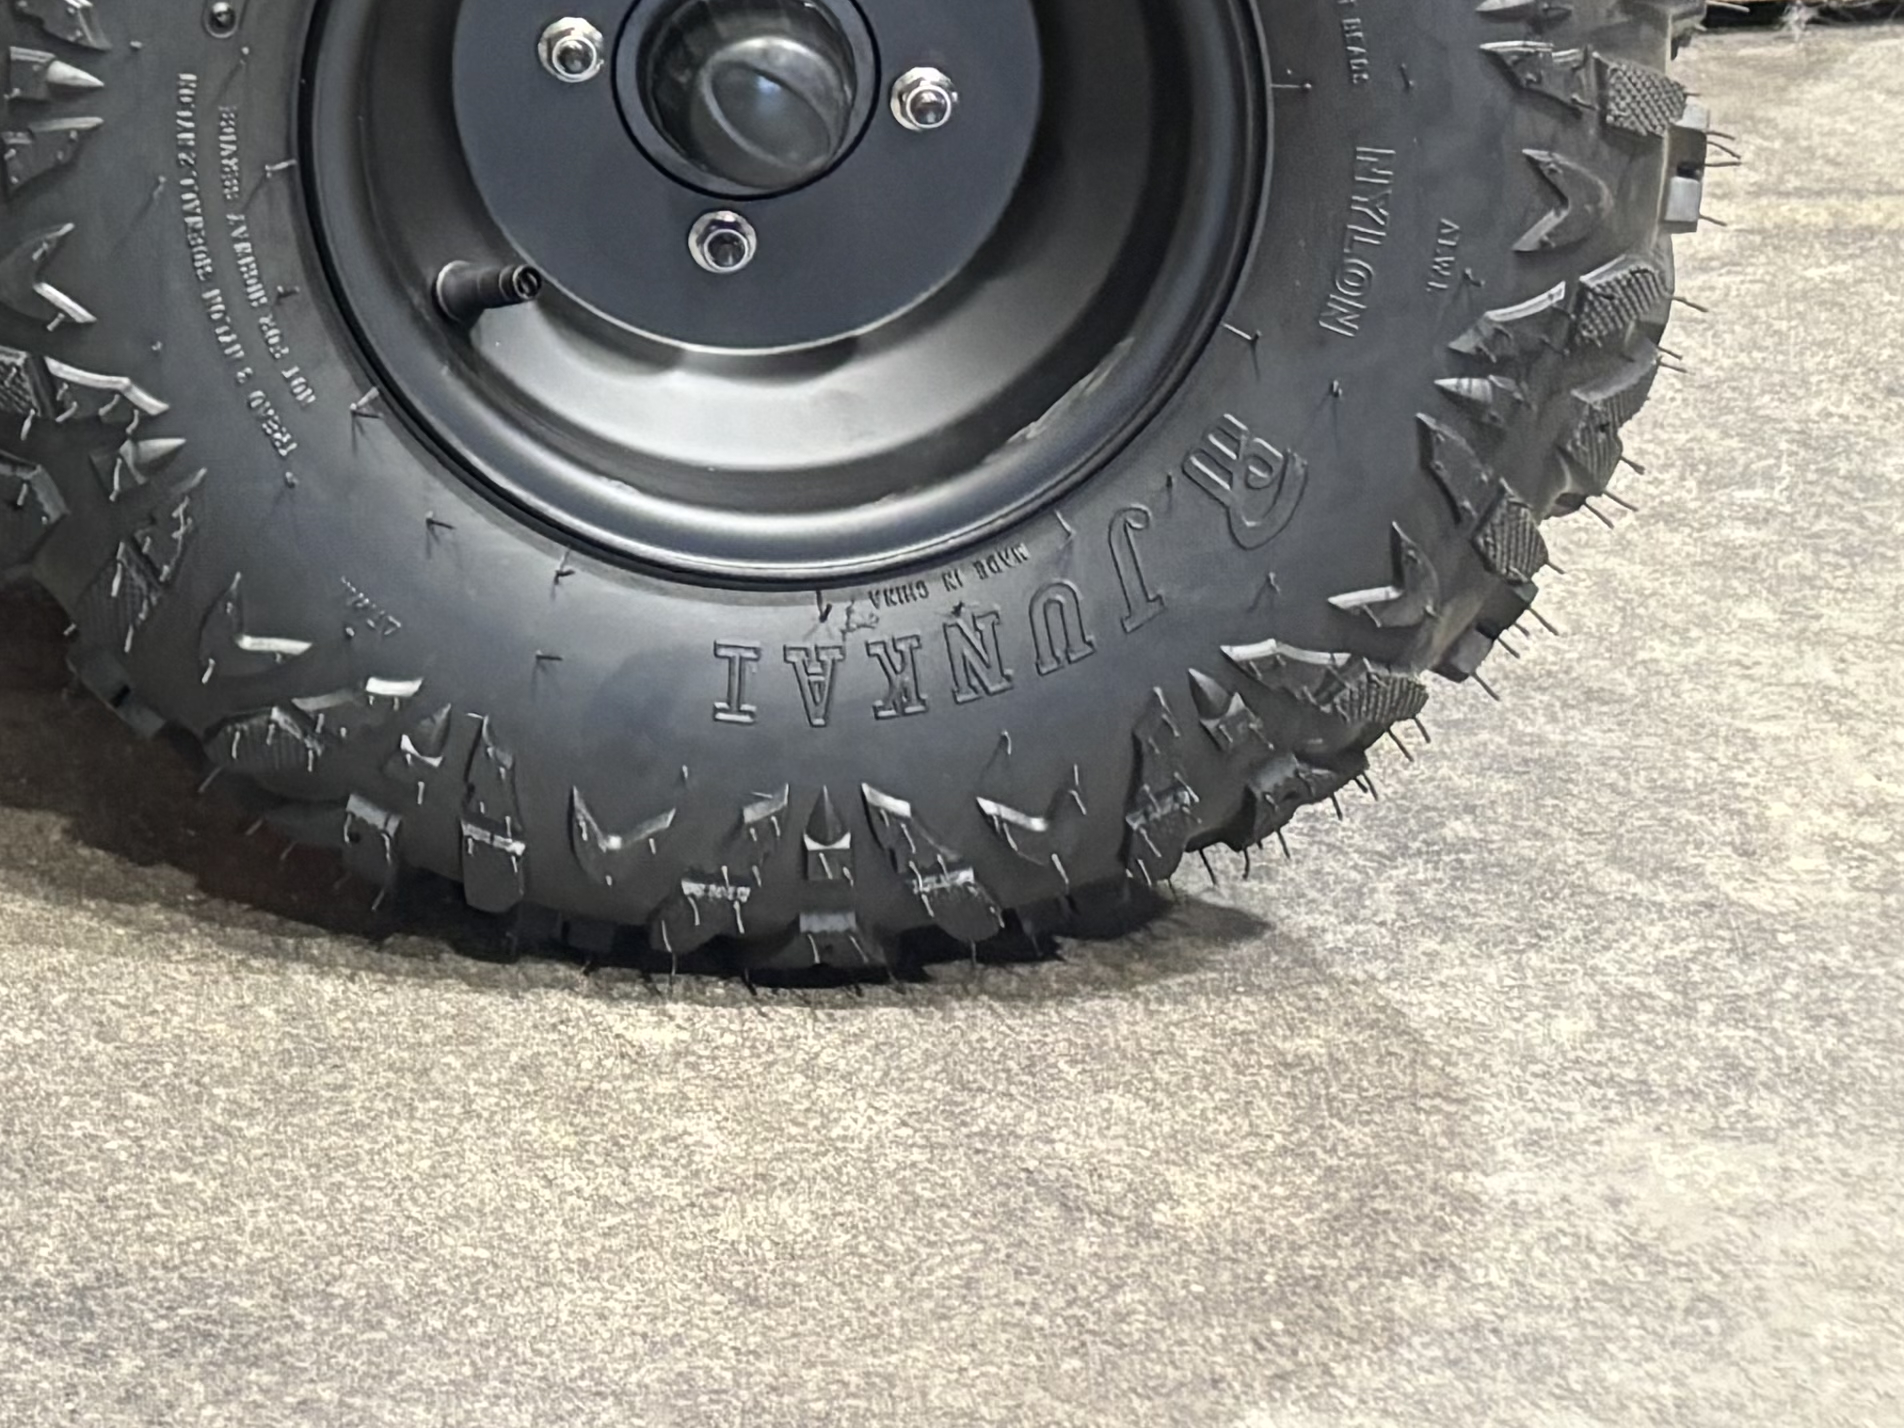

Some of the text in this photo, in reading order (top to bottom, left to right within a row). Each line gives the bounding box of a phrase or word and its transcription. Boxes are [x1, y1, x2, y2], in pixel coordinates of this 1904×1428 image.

[1318, 146, 1397, 338] NYLON
[711, 501, 1164, 729] JUNKAI
[936, 569, 964, 592] IN
[973, 543, 1031, 580] MADE
